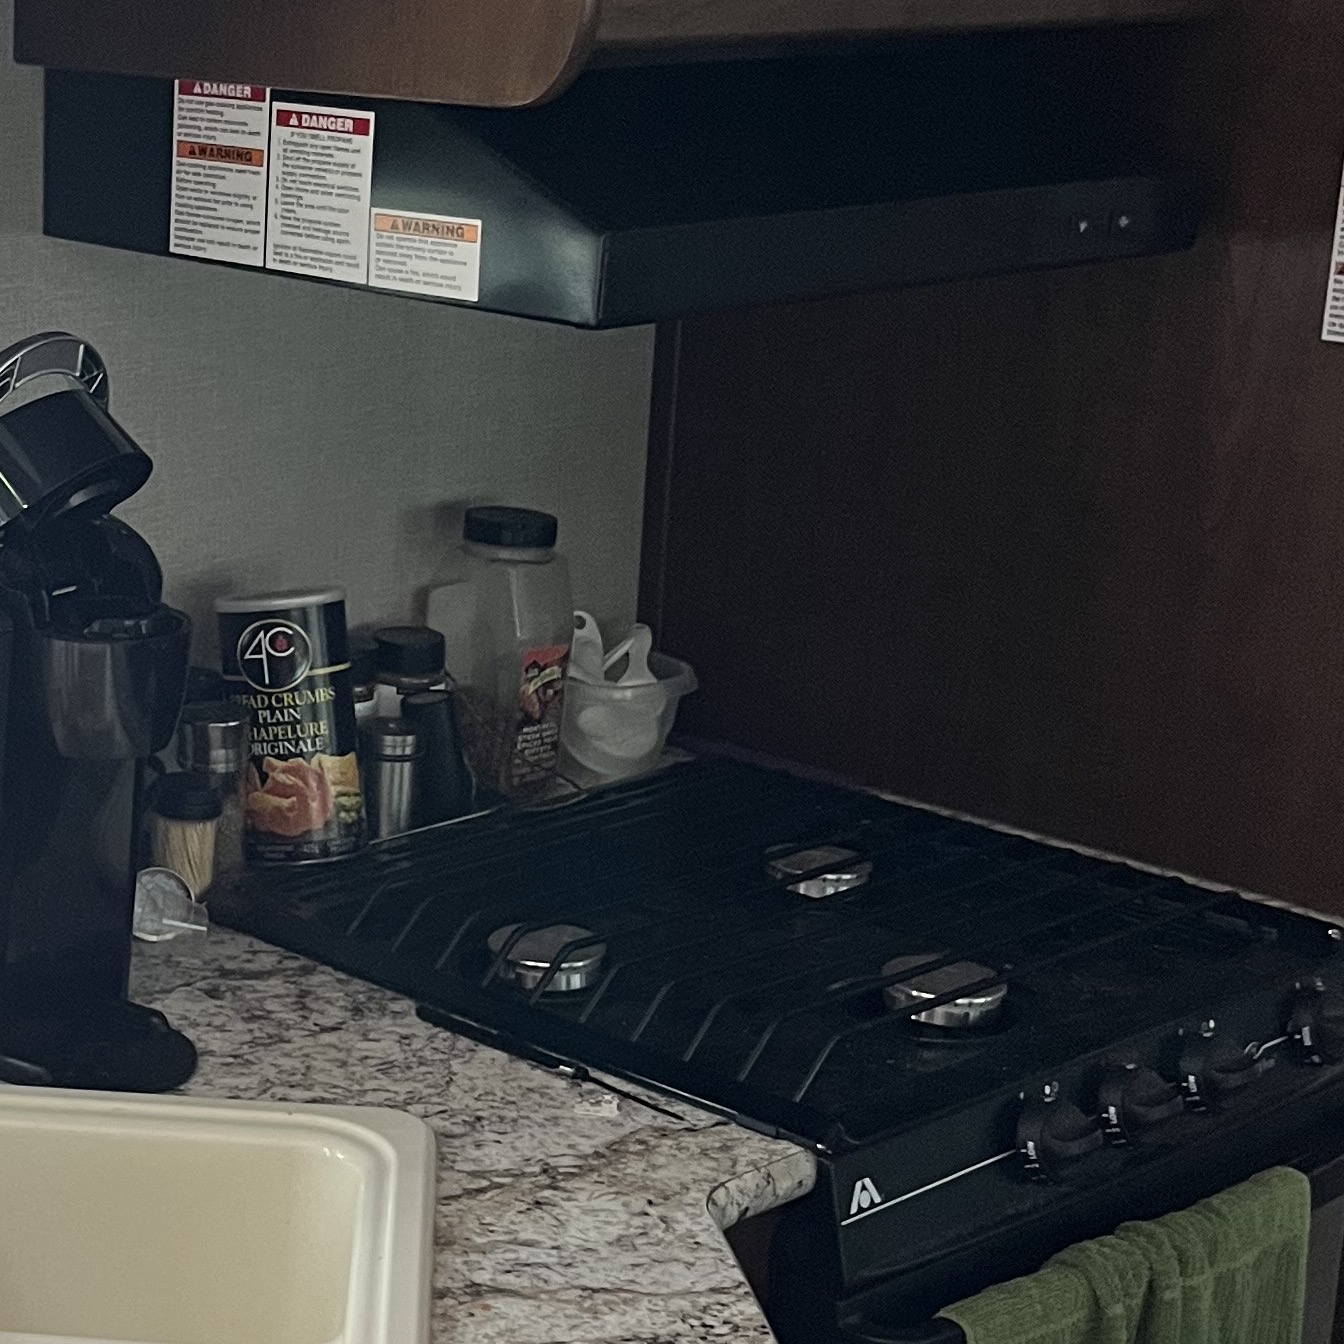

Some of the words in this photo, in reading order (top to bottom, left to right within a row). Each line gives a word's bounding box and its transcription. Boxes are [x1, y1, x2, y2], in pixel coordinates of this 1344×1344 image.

[203, 82, 252, 98] DANGER
[301, 114, 354, 132] DANGER
[198, 145, 253, 162] WARNING
[401, 219, 465, 238] WARNING
[244, 627, 295, 685] 4C
[271, 687, 336, 707] CRUMBS
[258, 707, 301, 723] PLAIN
[249, 720, 328, 741] HAPELURE
